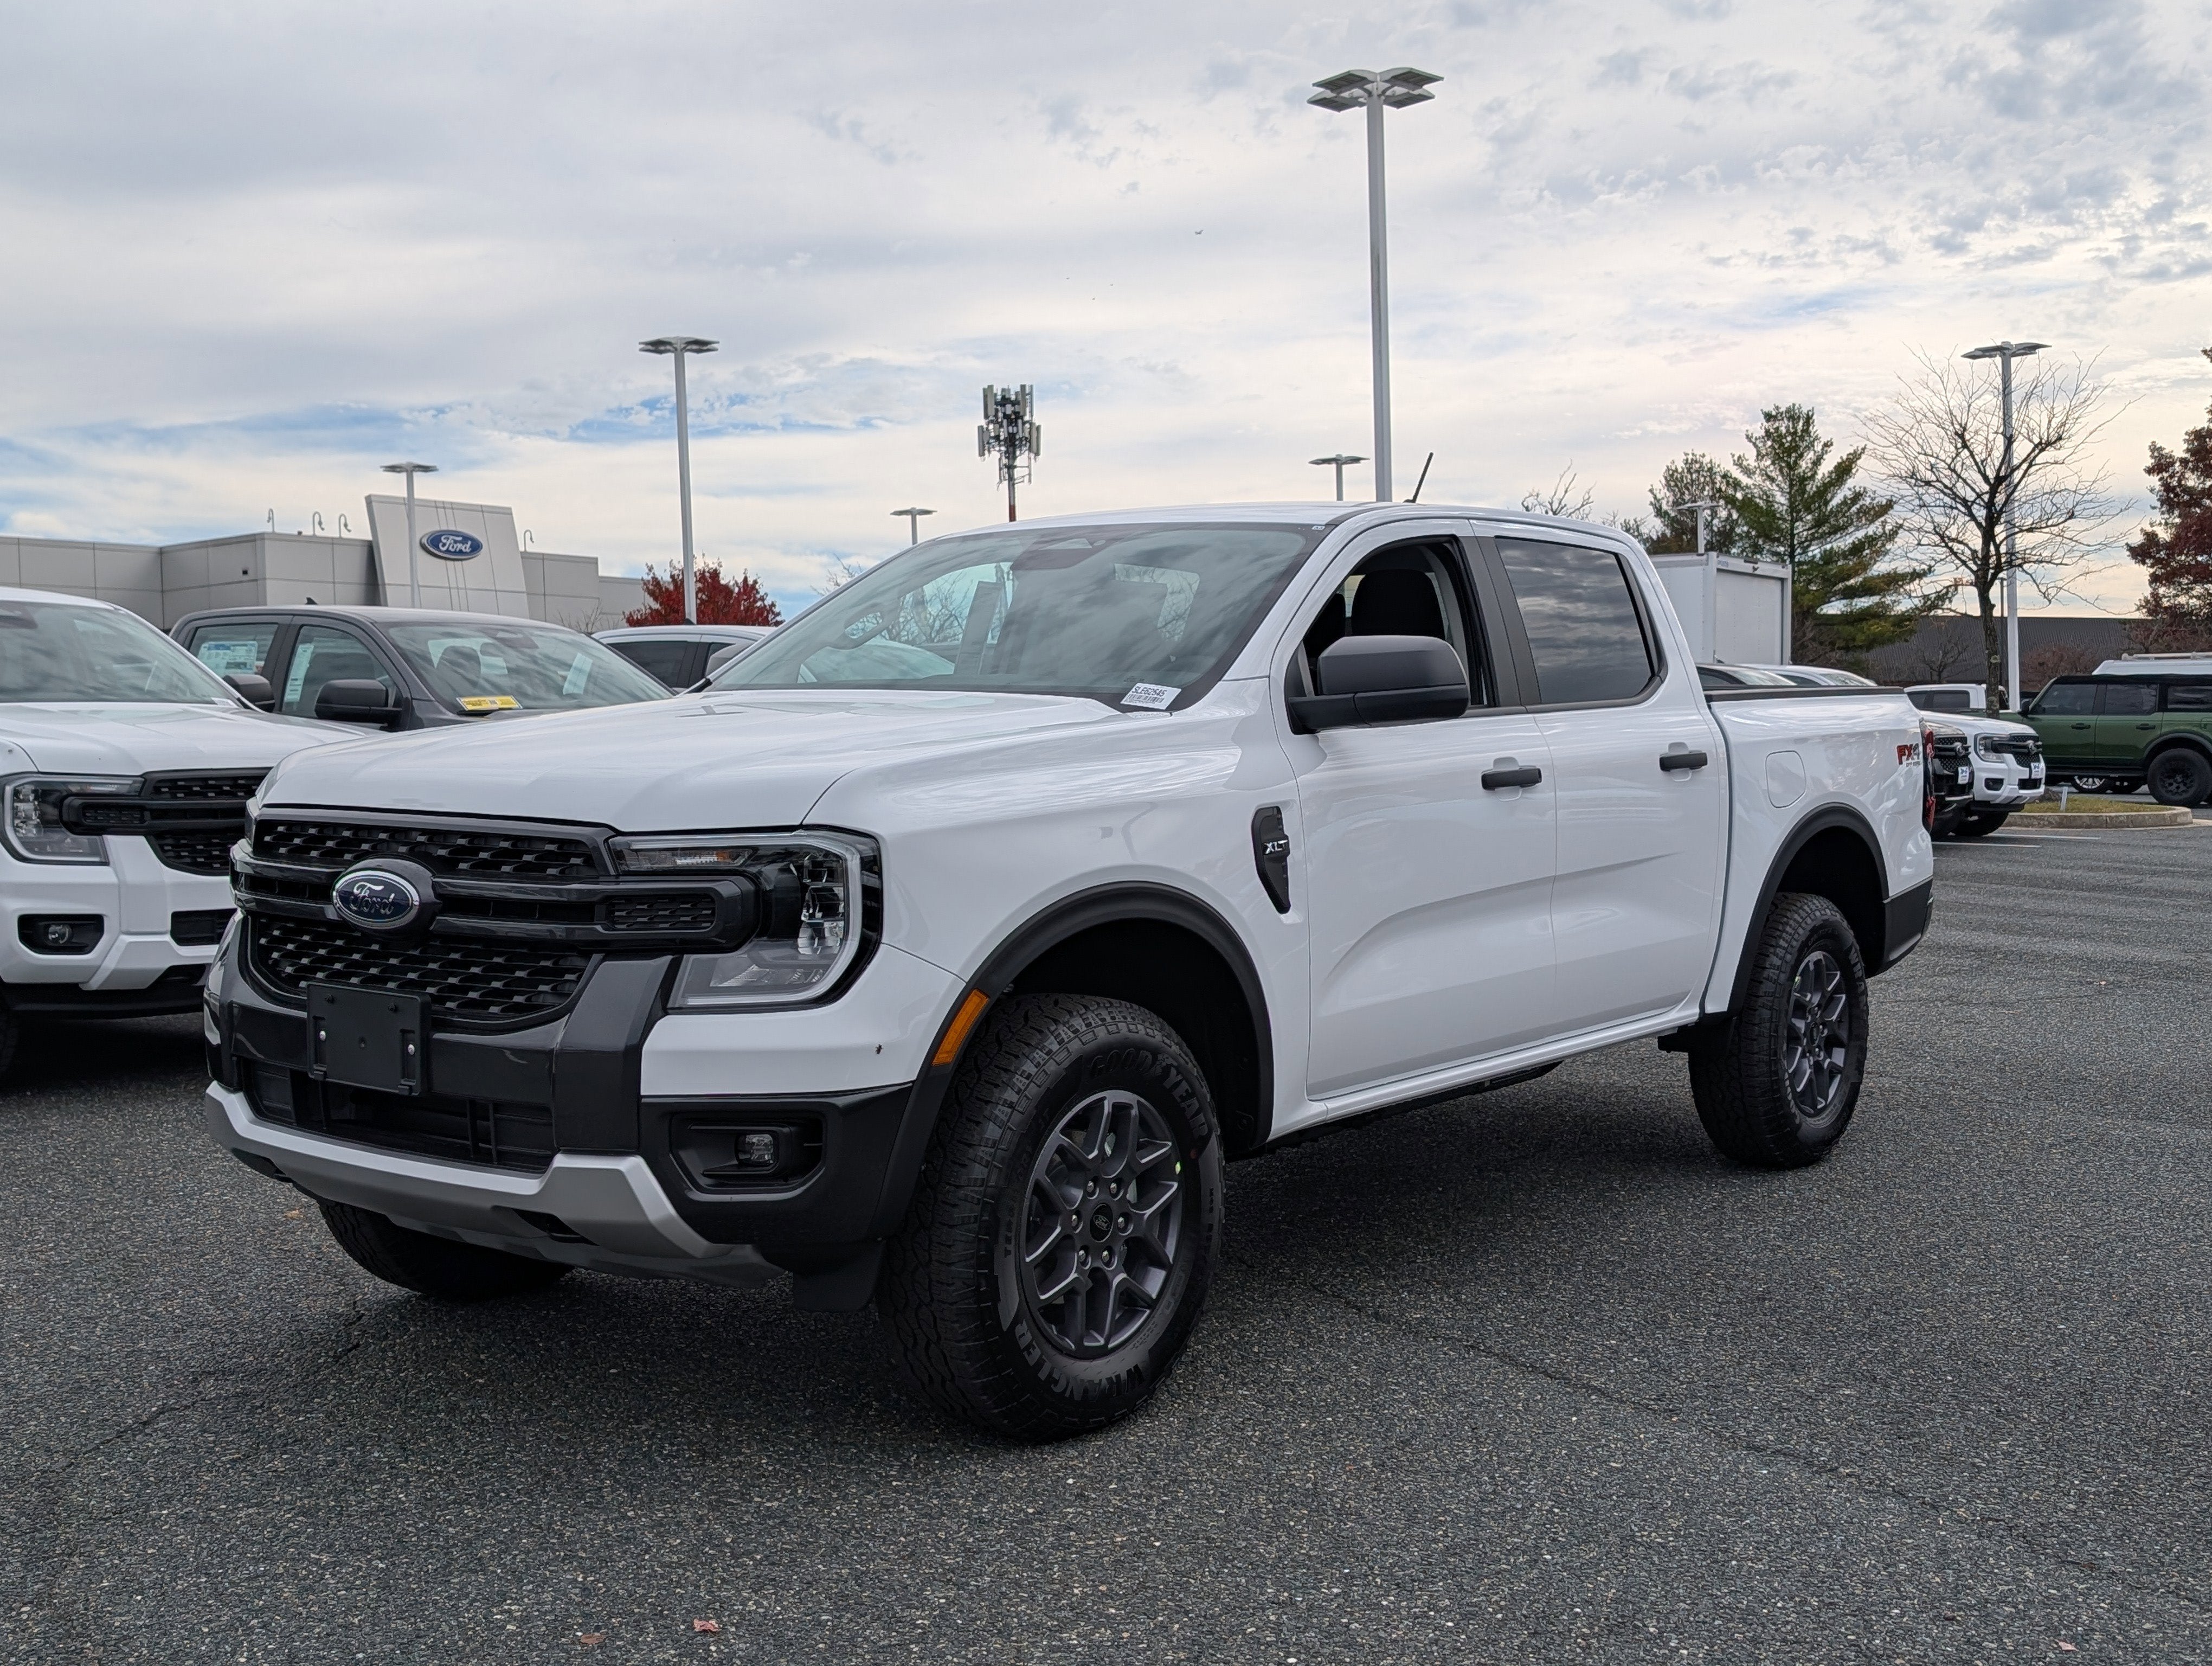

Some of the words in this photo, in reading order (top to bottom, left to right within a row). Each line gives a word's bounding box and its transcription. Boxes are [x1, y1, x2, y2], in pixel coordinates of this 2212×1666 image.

[439, 534, 472, 552] Ford
[1896, 742, 1920, 766] FX4
[1263, 840, 1288, 854] XLT
[349, 881, 395, 915] Ford
[1090, 1048, 1208, 1140] GOODYEAR
[1014, 1318, 1144, 1401] WRANGLER
